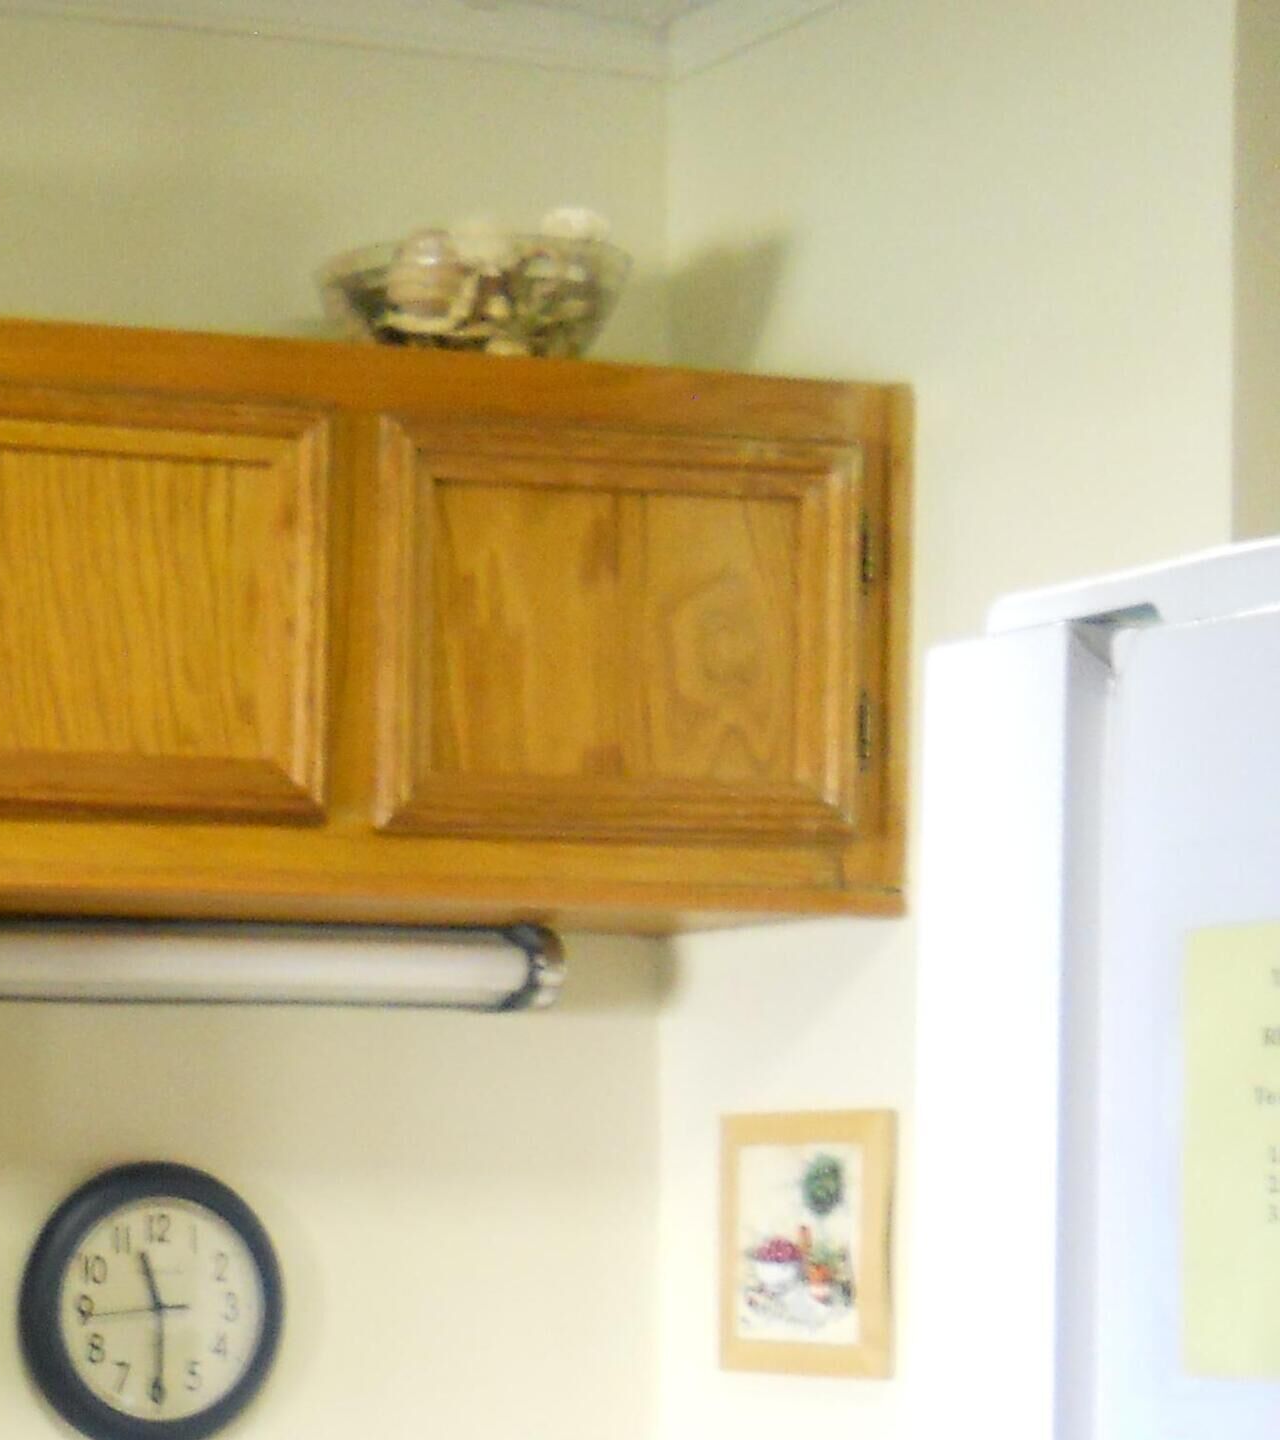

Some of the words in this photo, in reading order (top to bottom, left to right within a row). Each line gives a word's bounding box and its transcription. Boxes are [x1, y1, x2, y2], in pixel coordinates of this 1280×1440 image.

[113, 1226, 130, 1254] 11
[146, 1213, 171, 1243] 12
[83, 1254, 108, 1285] 10
[214, 1252, 230, 1283] 2
[77, 1293, 95, 1326] 9
[223, 1291, 240, 1322] 3
[87, 1333, 105, 1364] 8
[210, 1333, 227, 1357] 4
[114, 1360, 131, 1394] 7
[184, 1360, 202, 1391] 5
